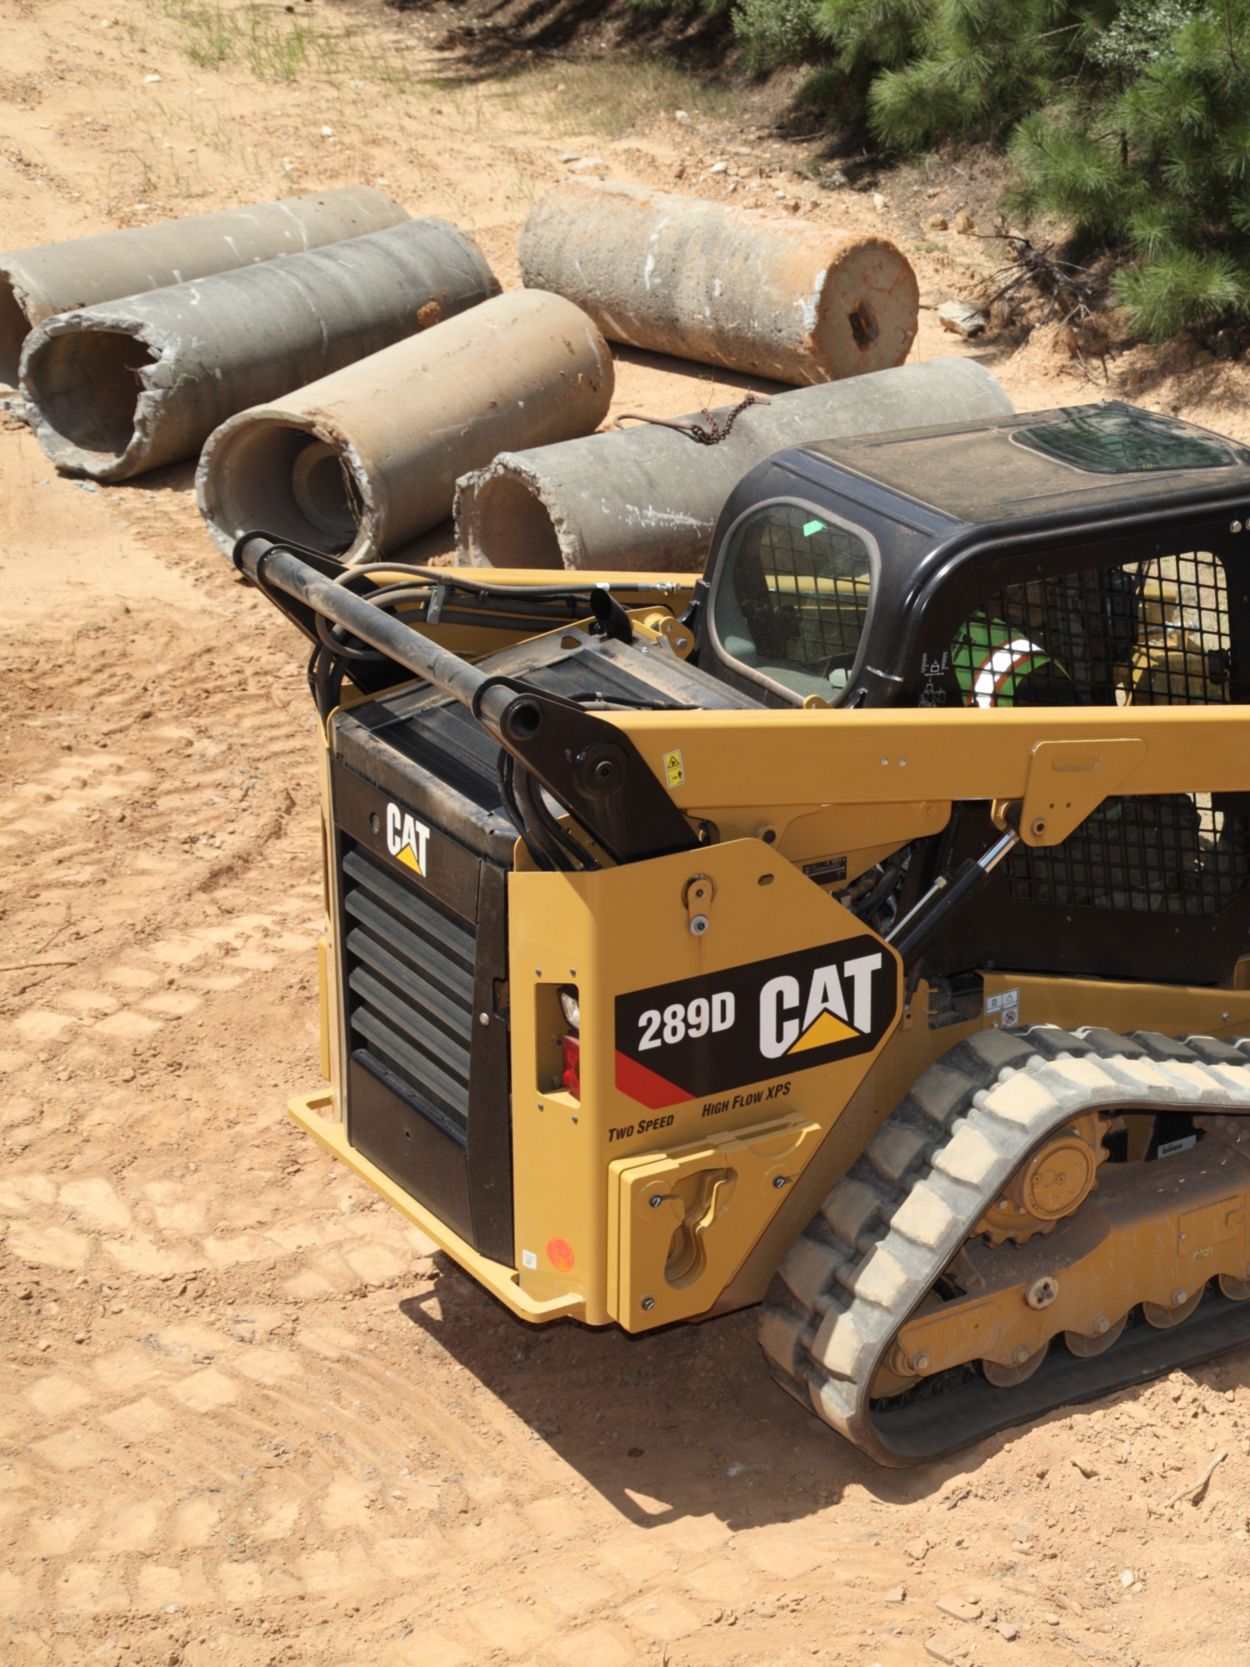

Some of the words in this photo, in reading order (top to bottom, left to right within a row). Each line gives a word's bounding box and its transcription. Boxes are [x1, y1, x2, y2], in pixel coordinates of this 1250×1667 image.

[387, 802, 430, 878] CAT
[637, 991, 736, 1052] 289D
[759, 952, 883, 1059] CAT
[766, 1081, 792, 1100] XPS
